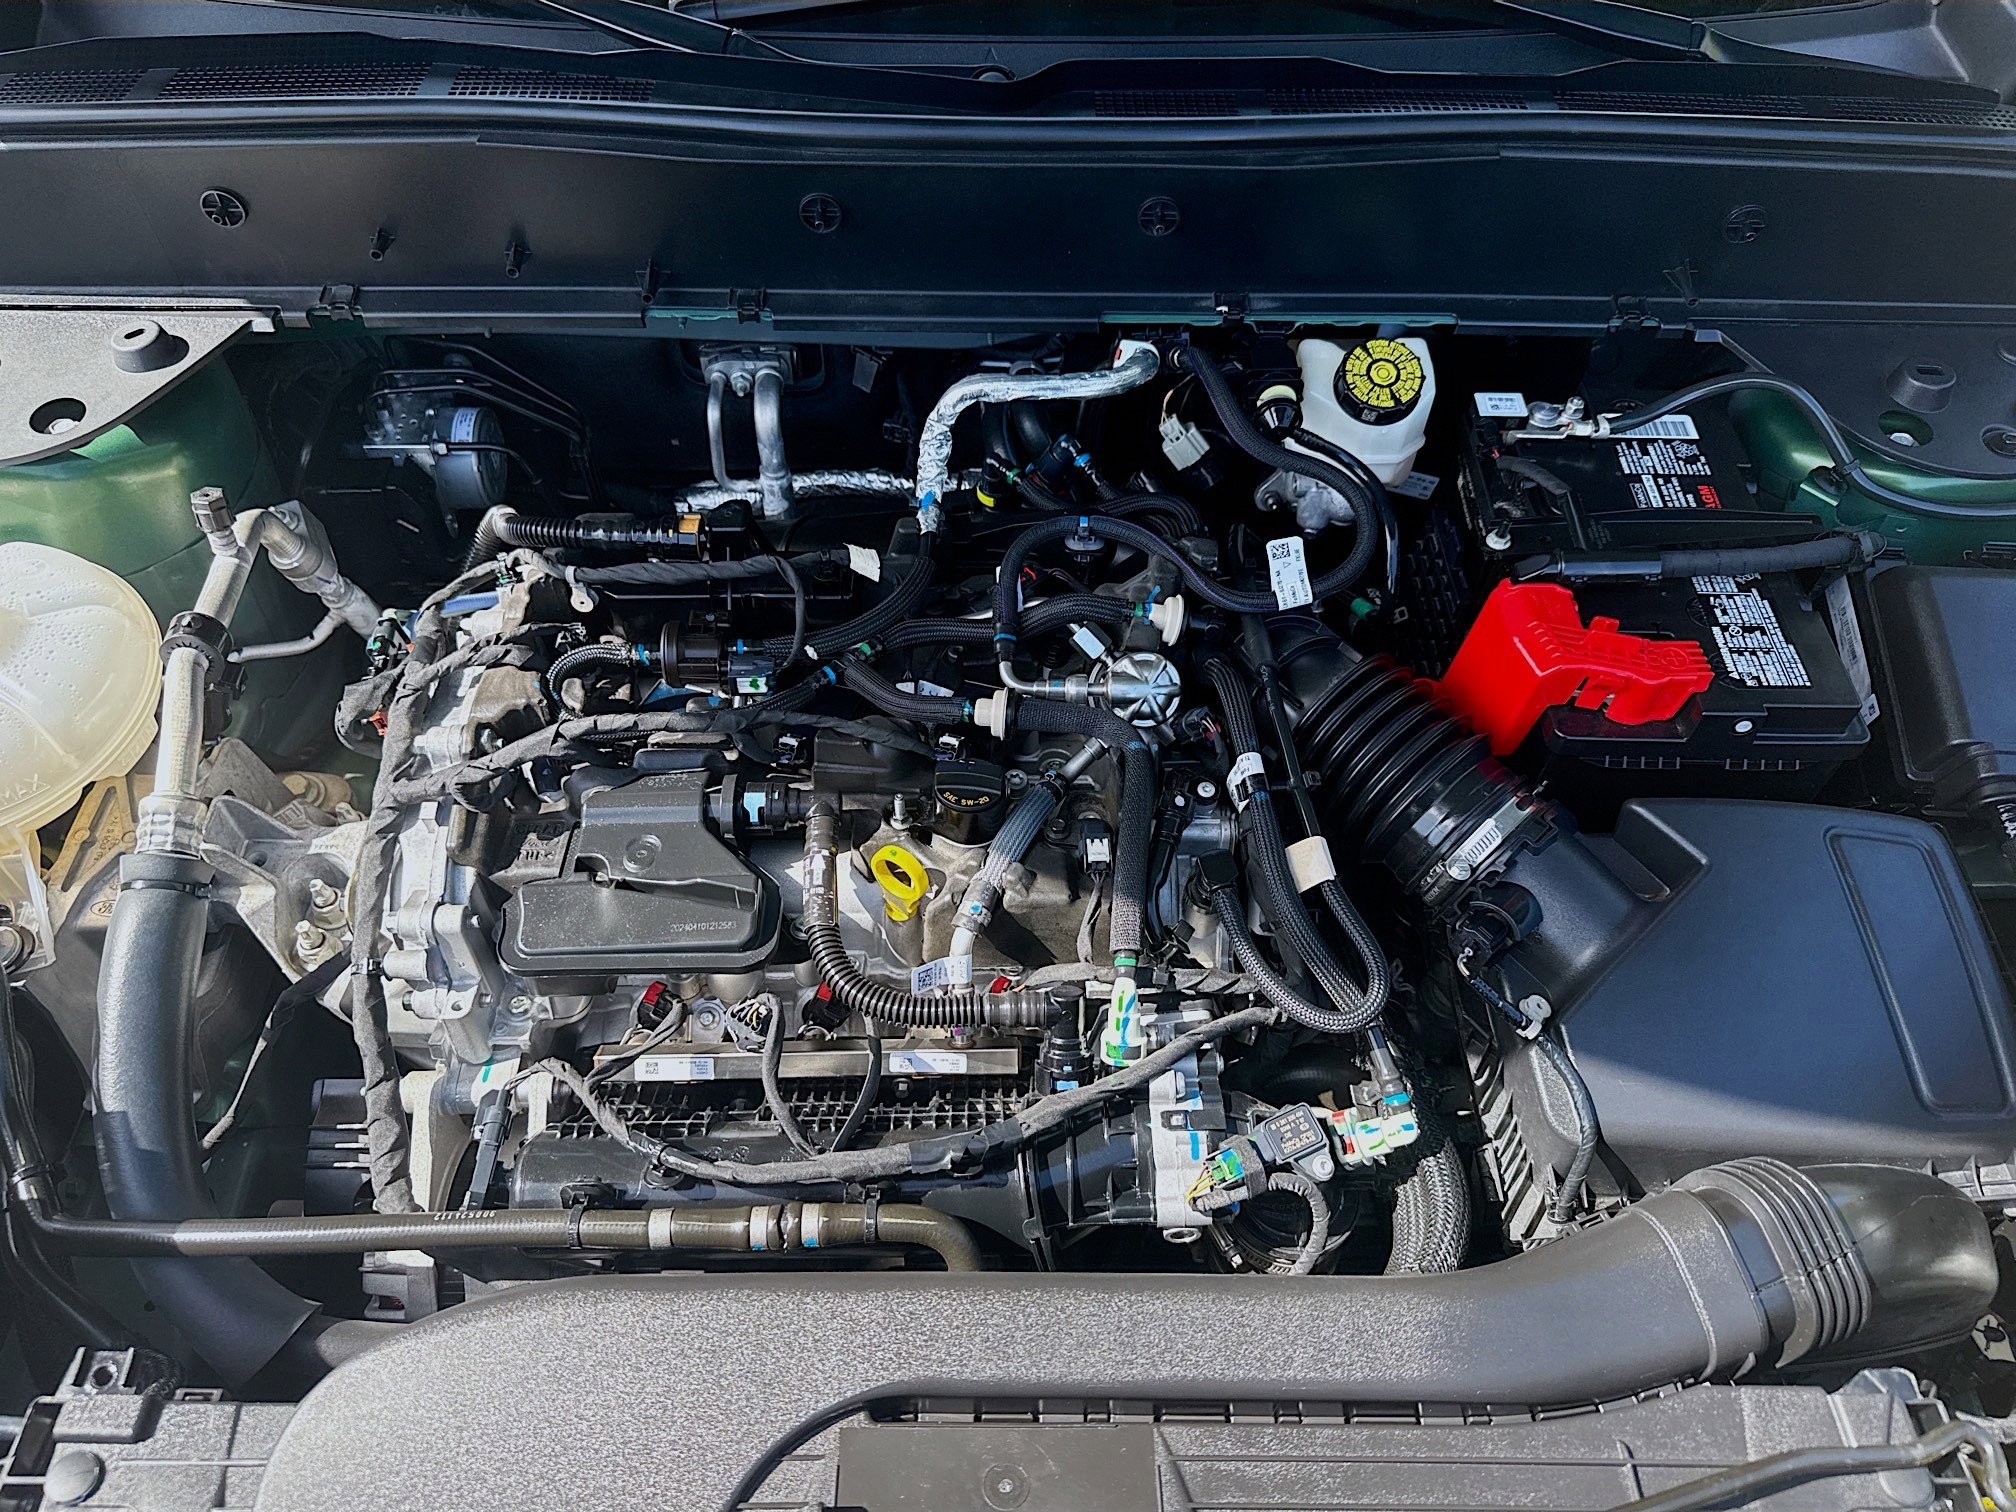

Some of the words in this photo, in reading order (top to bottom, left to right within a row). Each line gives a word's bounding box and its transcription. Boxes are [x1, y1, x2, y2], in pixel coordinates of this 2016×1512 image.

[1297, 568, 1309, 598] AUTOMOTIVE
[1289, 585, 1299, 605] FoMoCo
[942, 791, 959, 803] SAE
[960, 795, 990, 806] 5W-20
